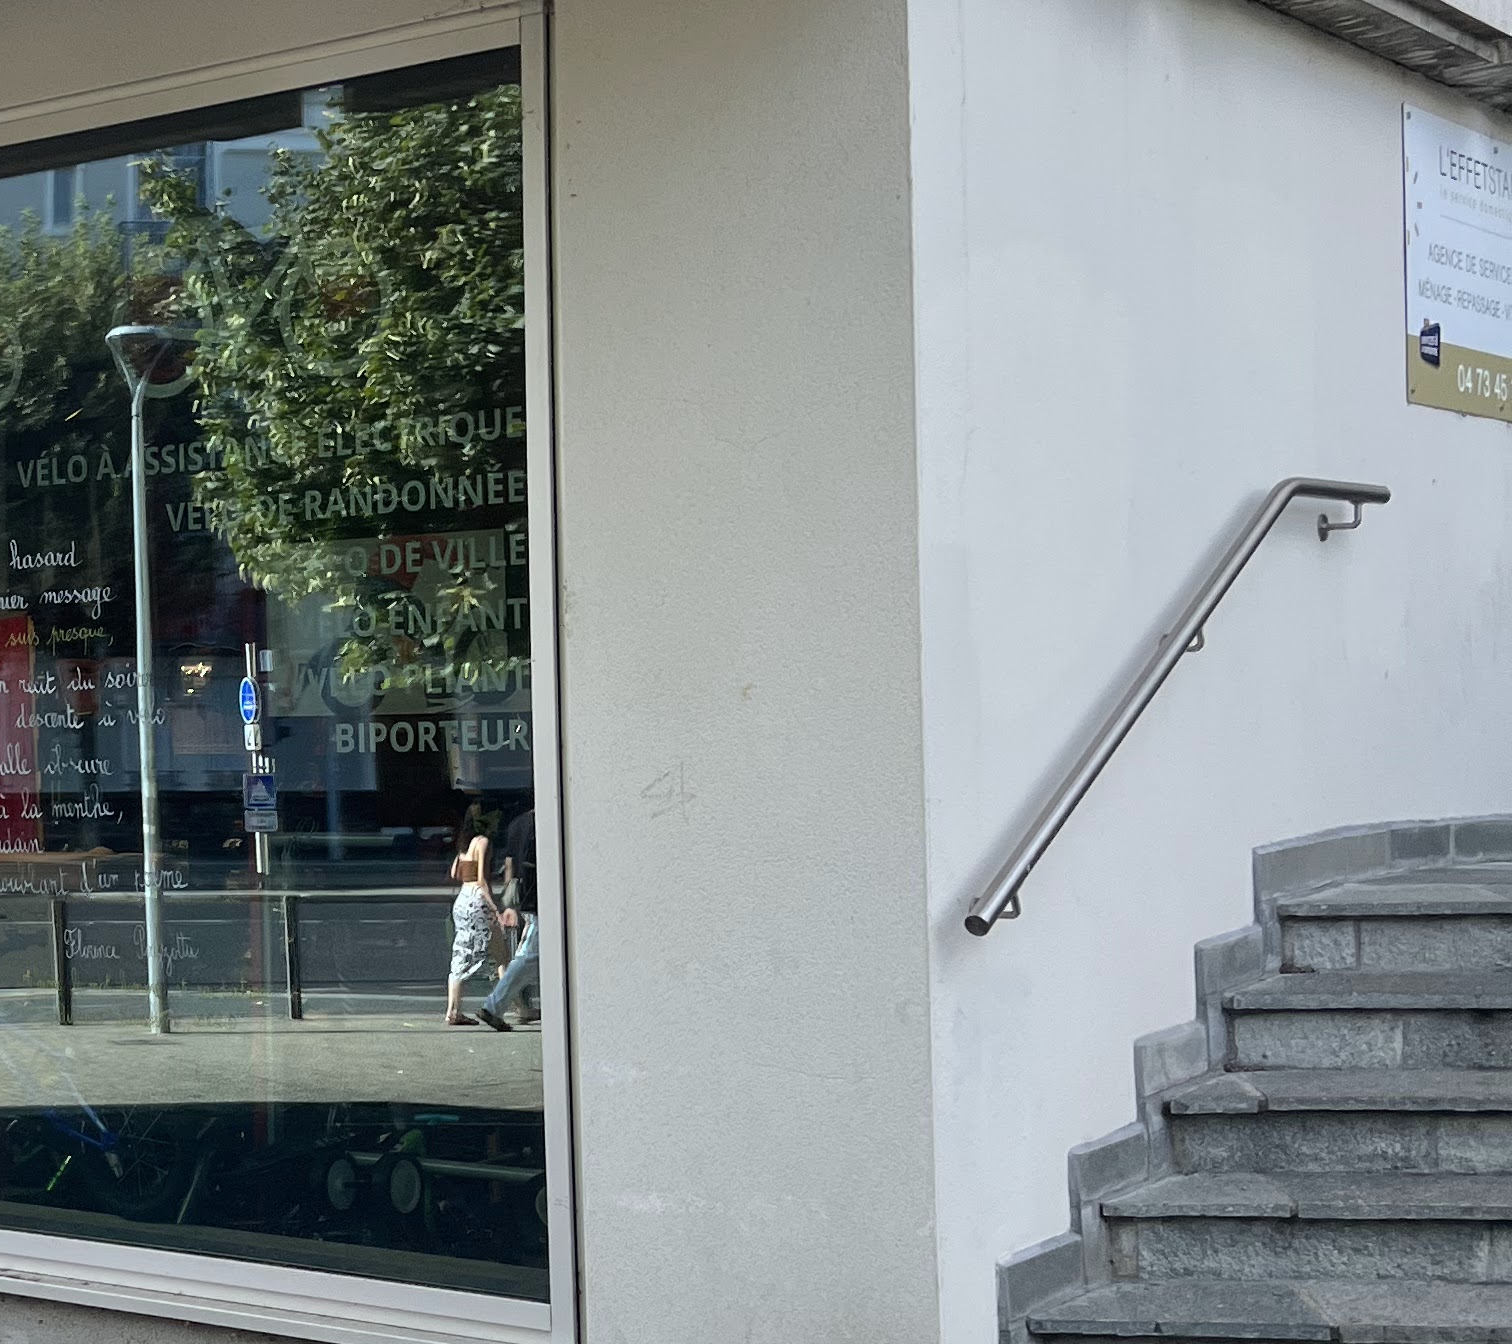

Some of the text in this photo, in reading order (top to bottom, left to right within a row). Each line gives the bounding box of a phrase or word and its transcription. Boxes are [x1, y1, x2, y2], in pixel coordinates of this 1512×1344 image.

[1428, 242, 1464, 271] AGENCE
[1465, 253, 1477, 275] DE
[1457, 364, 1508, 401] 04 73 45
[17, 442, 88, 488] VÉLO
[96, 443, 116, 481] À
[304, 463, 524, 522] RANDONNÉE
[9, 539, 83, 569] hasard
[380, 541, 421, 575] DE
[431, 533, 527, 571] VILLE
[39, 586, 118, 619] message
[391, 598, 527, 634] ENFANT
[5, 631, 39, 649] suis
[46, 625, 114, 656] presque,
[67, 666, 95, 690] du
[15, 703, 85, 730] descente
[98, 701, 116, 727] à
[336, 718, 530, 754] BIPORTEUR
[44, 743, 116, 776] obscure
[21, 786, 42, 819] la
